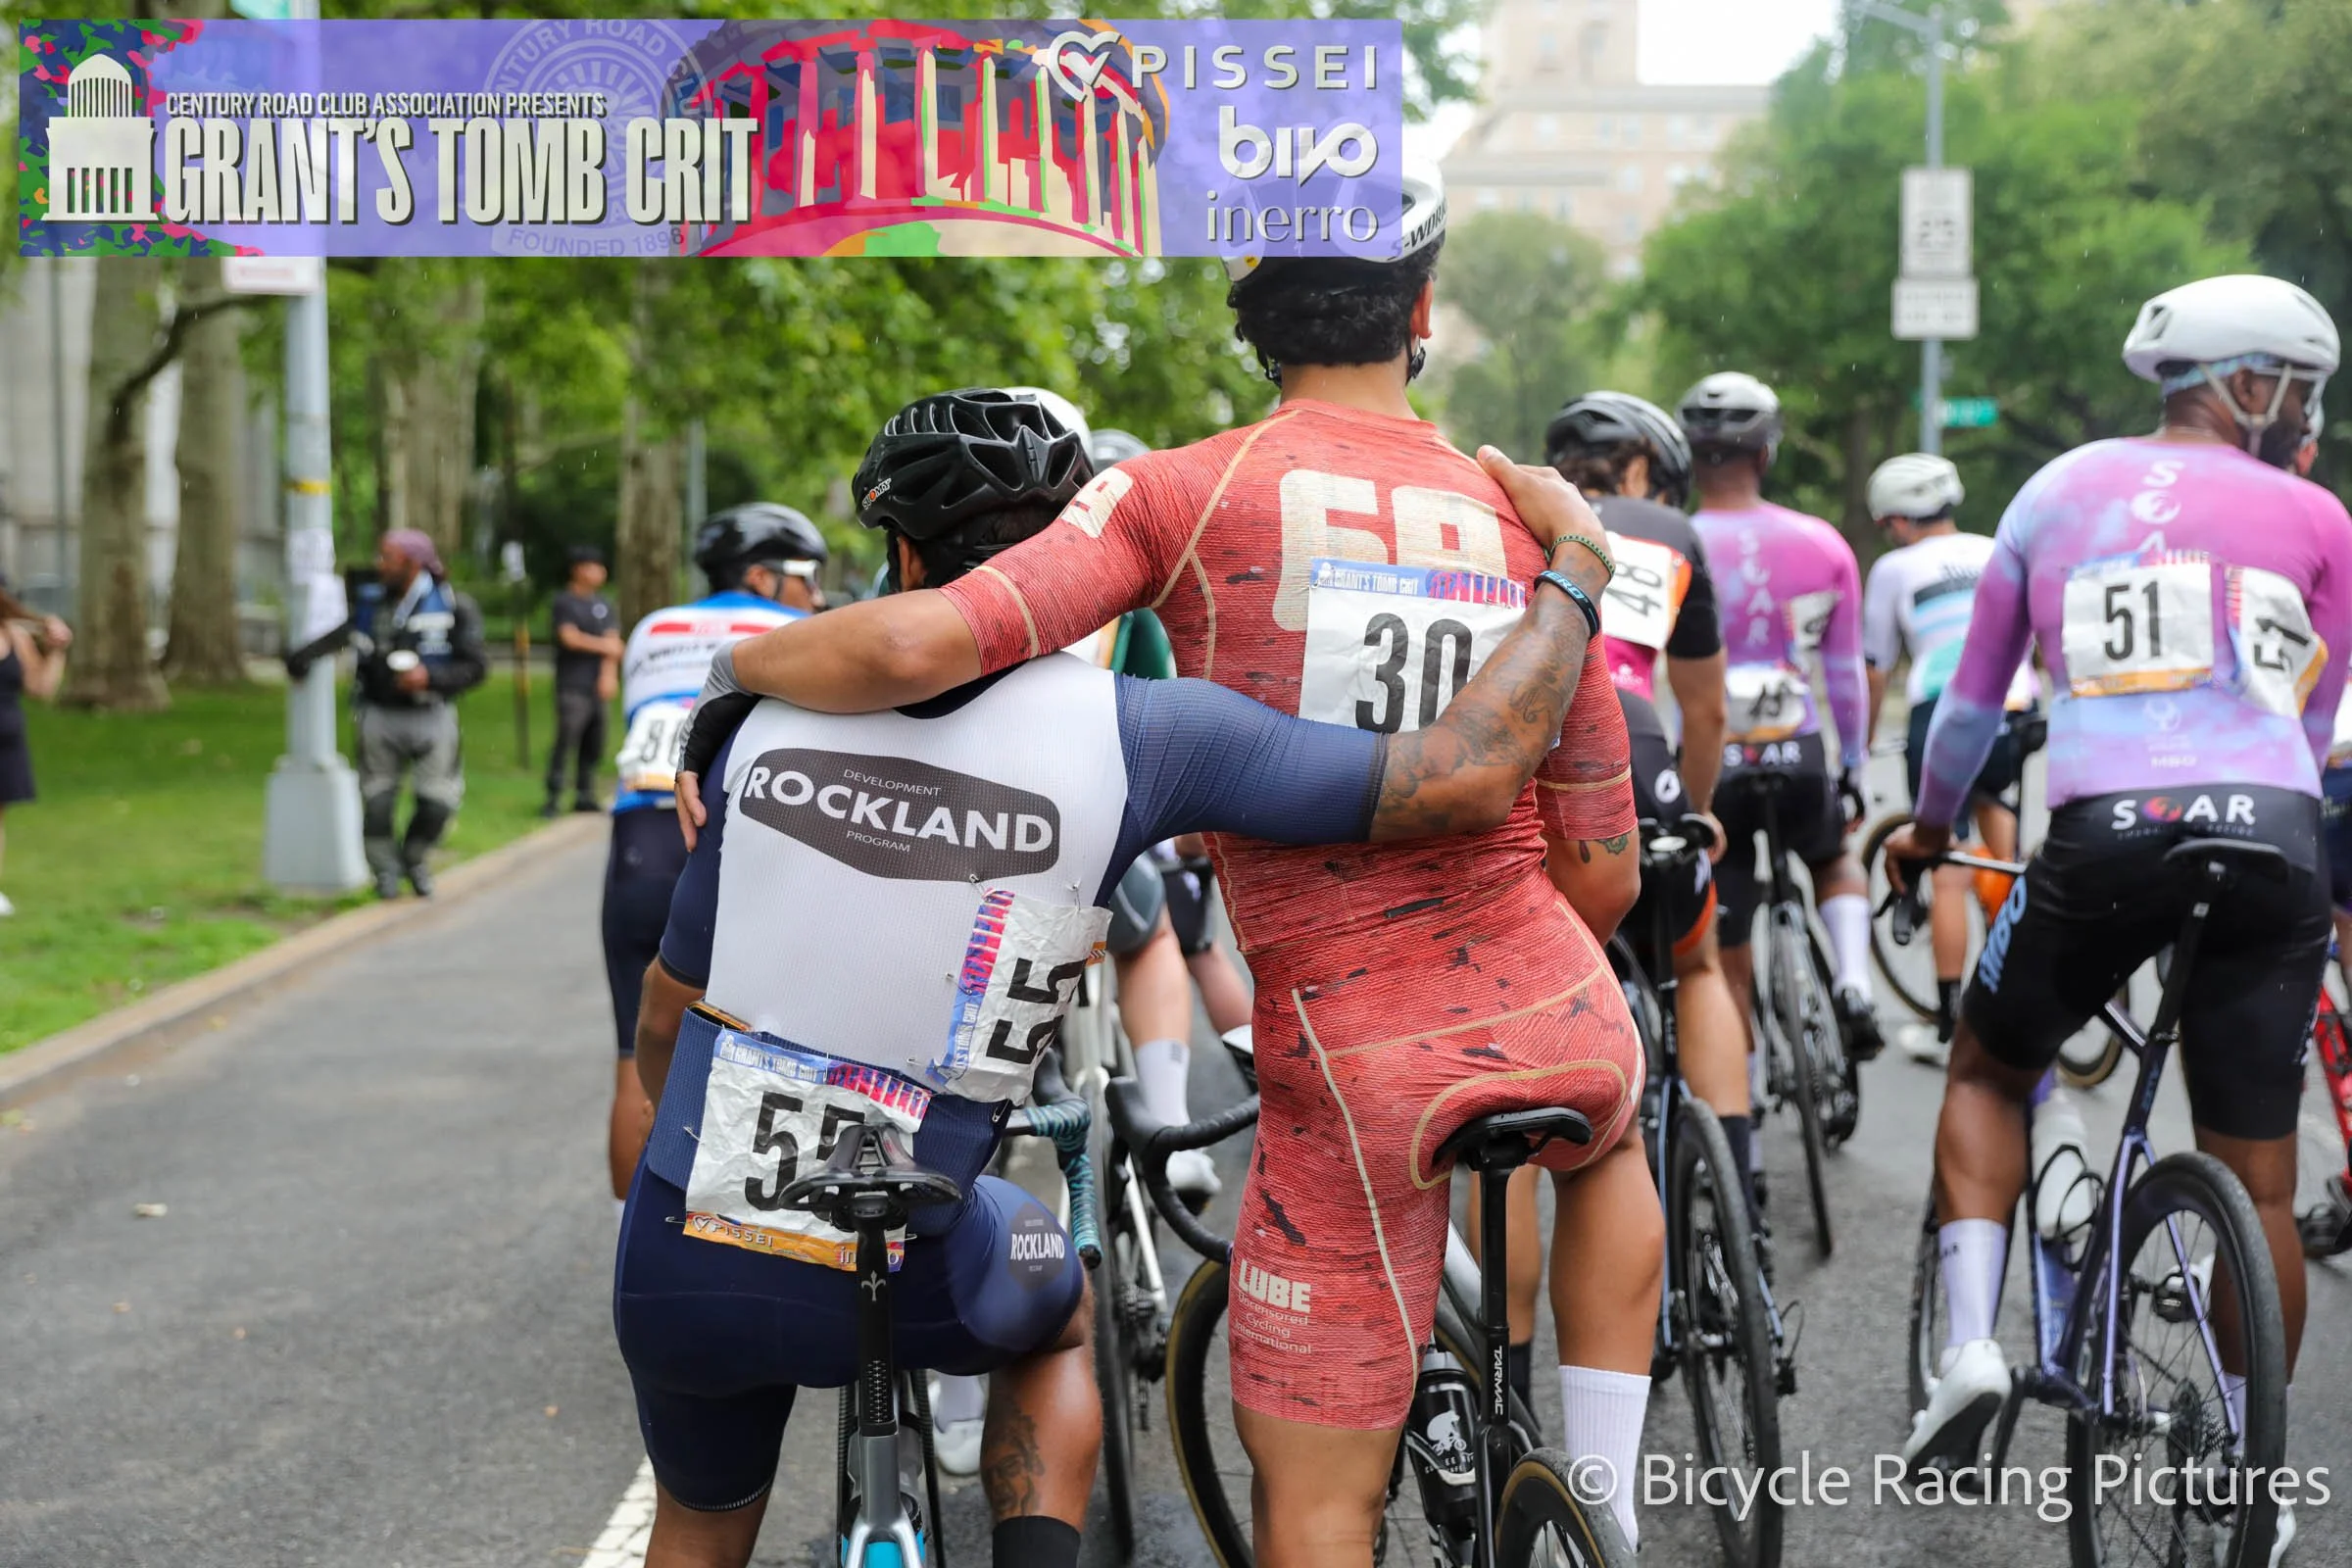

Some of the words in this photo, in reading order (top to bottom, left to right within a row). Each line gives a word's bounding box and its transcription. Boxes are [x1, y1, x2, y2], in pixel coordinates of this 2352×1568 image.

[2104, 581, 2162, 661] 51
[1355, 612, 1472, 734] 30
[843, 768, 941, 797] DEVELOPMENT
[744, 766, 1054, 854] ROCKLAND
[847, 830, 911, 854] PROGRAM
[1010, 1232, 1065, 1261] ROCKLAND
[1238, 1258, 1311, 1313] LUBE
[1238, 1293, 1309, 1326] Uncensored
[1246, 1312, 1291, 1339] Cycling
[1494, 1345, 1503, 1416] TARMAC
